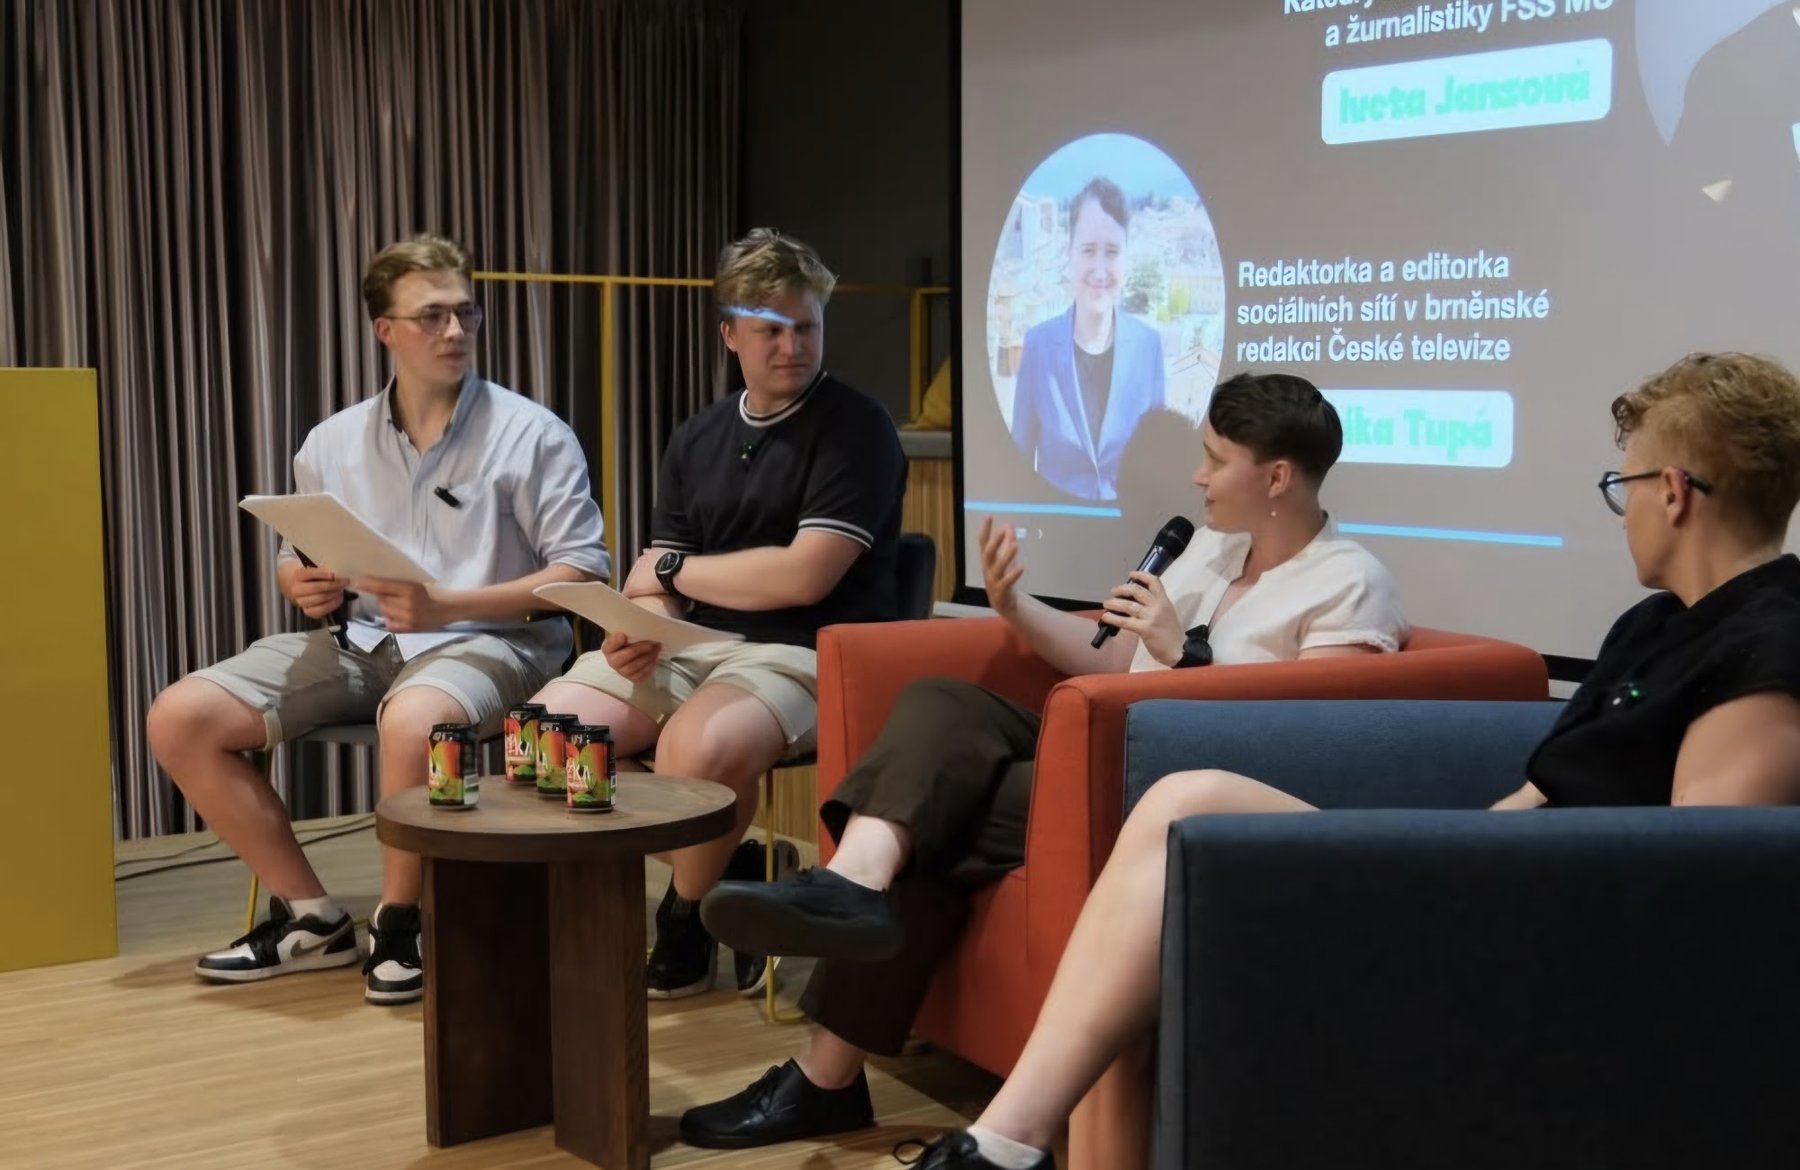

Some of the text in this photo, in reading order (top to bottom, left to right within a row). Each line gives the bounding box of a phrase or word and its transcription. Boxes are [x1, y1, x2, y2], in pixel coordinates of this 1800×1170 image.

[1325, 25, 1340, 47] a
[1346, 0, 1493, 44] žurnalistiky
[1501, 0, 1556, 22] FSS
[1238, 250, 1509, 288] Redaktorka a editorka
[1237, 288, 1550, 325] sociálních sítí v brněnské
[1237, 327, 1511, 363] redakci České televize
[1403, 407, 1493, 462] Tupá
